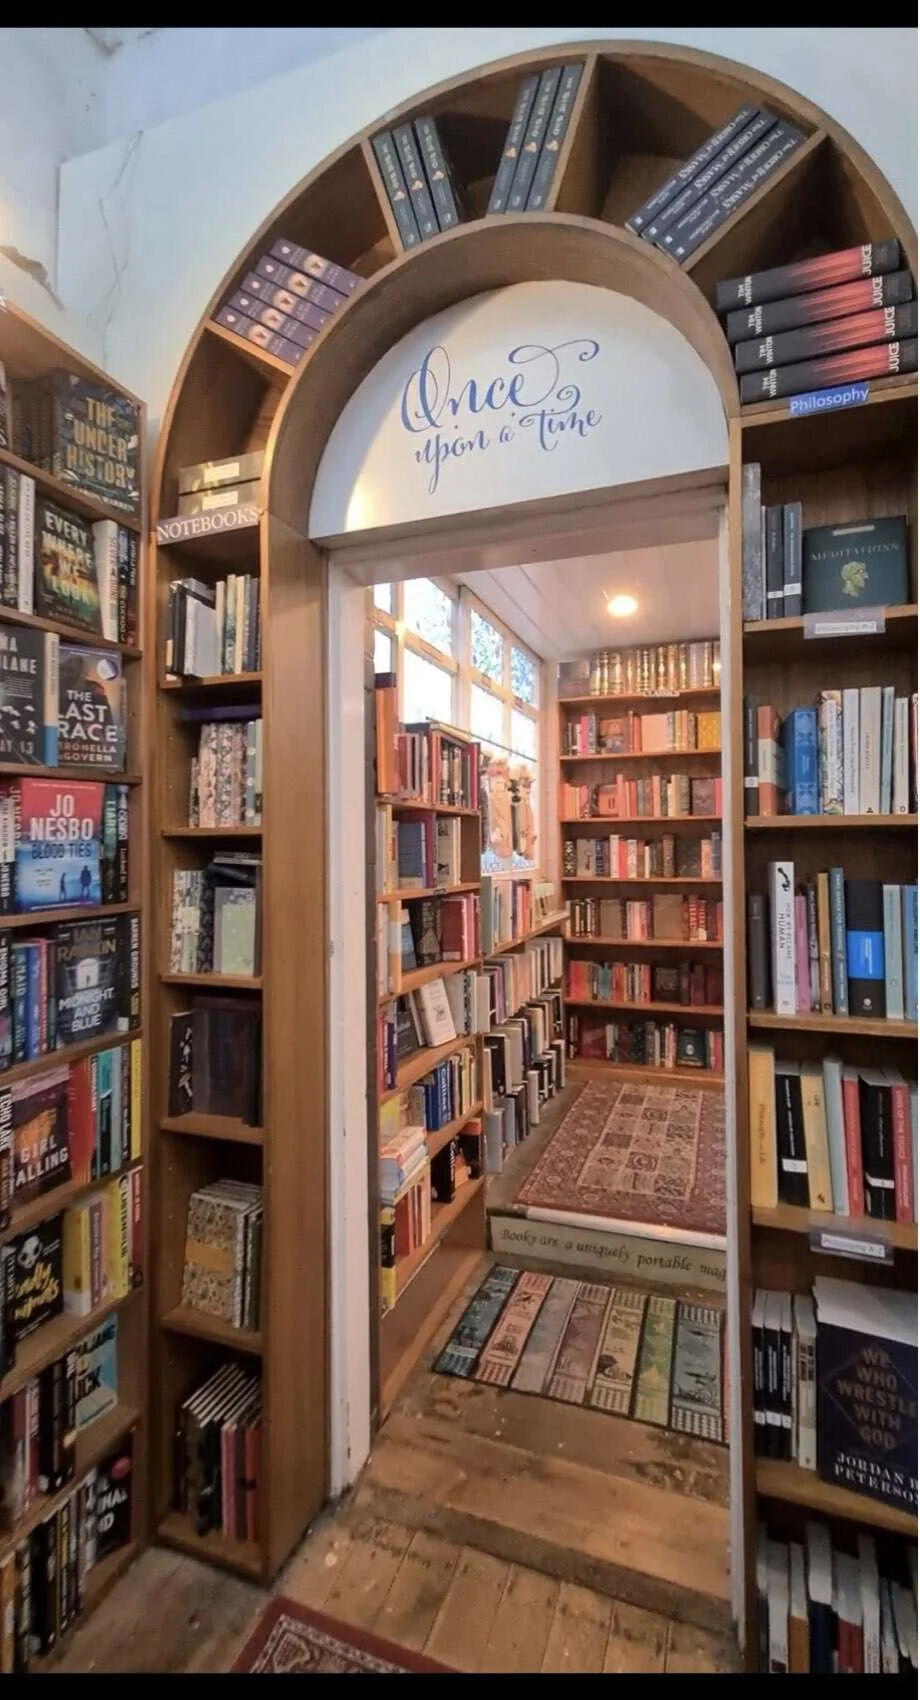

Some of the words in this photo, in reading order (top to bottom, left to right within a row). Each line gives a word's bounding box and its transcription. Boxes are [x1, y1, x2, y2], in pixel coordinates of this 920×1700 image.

[862, 244, 872, 275] JUICE
[872, 276, 883, 306] JUICE
[885, 306, 895, 336] JUICE
[888, 342, 900, 372] JUICE
[401, 339, 599, 432] Once
[86, 397, 115, 428] THE
[790, 388, 869, 414] Philosophy
[74, 419, 128, 462] UNDER
[66, 444, 136, 491] HISTORY
[415, 431, 490, 495] upon
[499, 426, 515, 443] a
[44, 511, 88, 543] EVERY
[157, 506, 260, 541] NOTEBOOKS
[42, 531, 93, 569] WHERE
[811, 542, 899, 561] MEDITATIONS
[0, 655, 37, 674] LANE
[66, 689, 92, 702] THE
[58, 702, 108, 722] AST
[57, 721, 118, 742] RACE
[20, 741, 34, 754] 13
[60, 752, 113, 762] GOVERN
[49, 794, 75, 817] JO
[105, 800, 116, 834] LIARS
[29, 817, 94, 841] NESBO
[32, 843, 65, 859] BLOOD
[69, 843, 92, 858] TIES
[777, 913, 785, 949] HUMAN
[59, 987, 115, 1011] MIDNIGHT
[74, 1003, 100, 1018] AND
[71, 1014, 102, 1033] BLUE
[21, 1134, 57, 1163] GIRL
[501, 1229, 537, 1246] Books
[539, 1237, 559, 1247] are
[564, 1241, 573, 1250] a
[576, 1241, 631, 1263] uniquely
[636, 1253, 694, 1272] portable
[862, 1347, 890, 1368] WE
[857, 1366, 897, 1388] WHO
[854, 1404, 901, 1430] WITH
[860, 1426, 896, 1449] GOD
[836, 1452, 905, 1484] JORDAN
[834, 1463, 918, 1504] PETERSO
